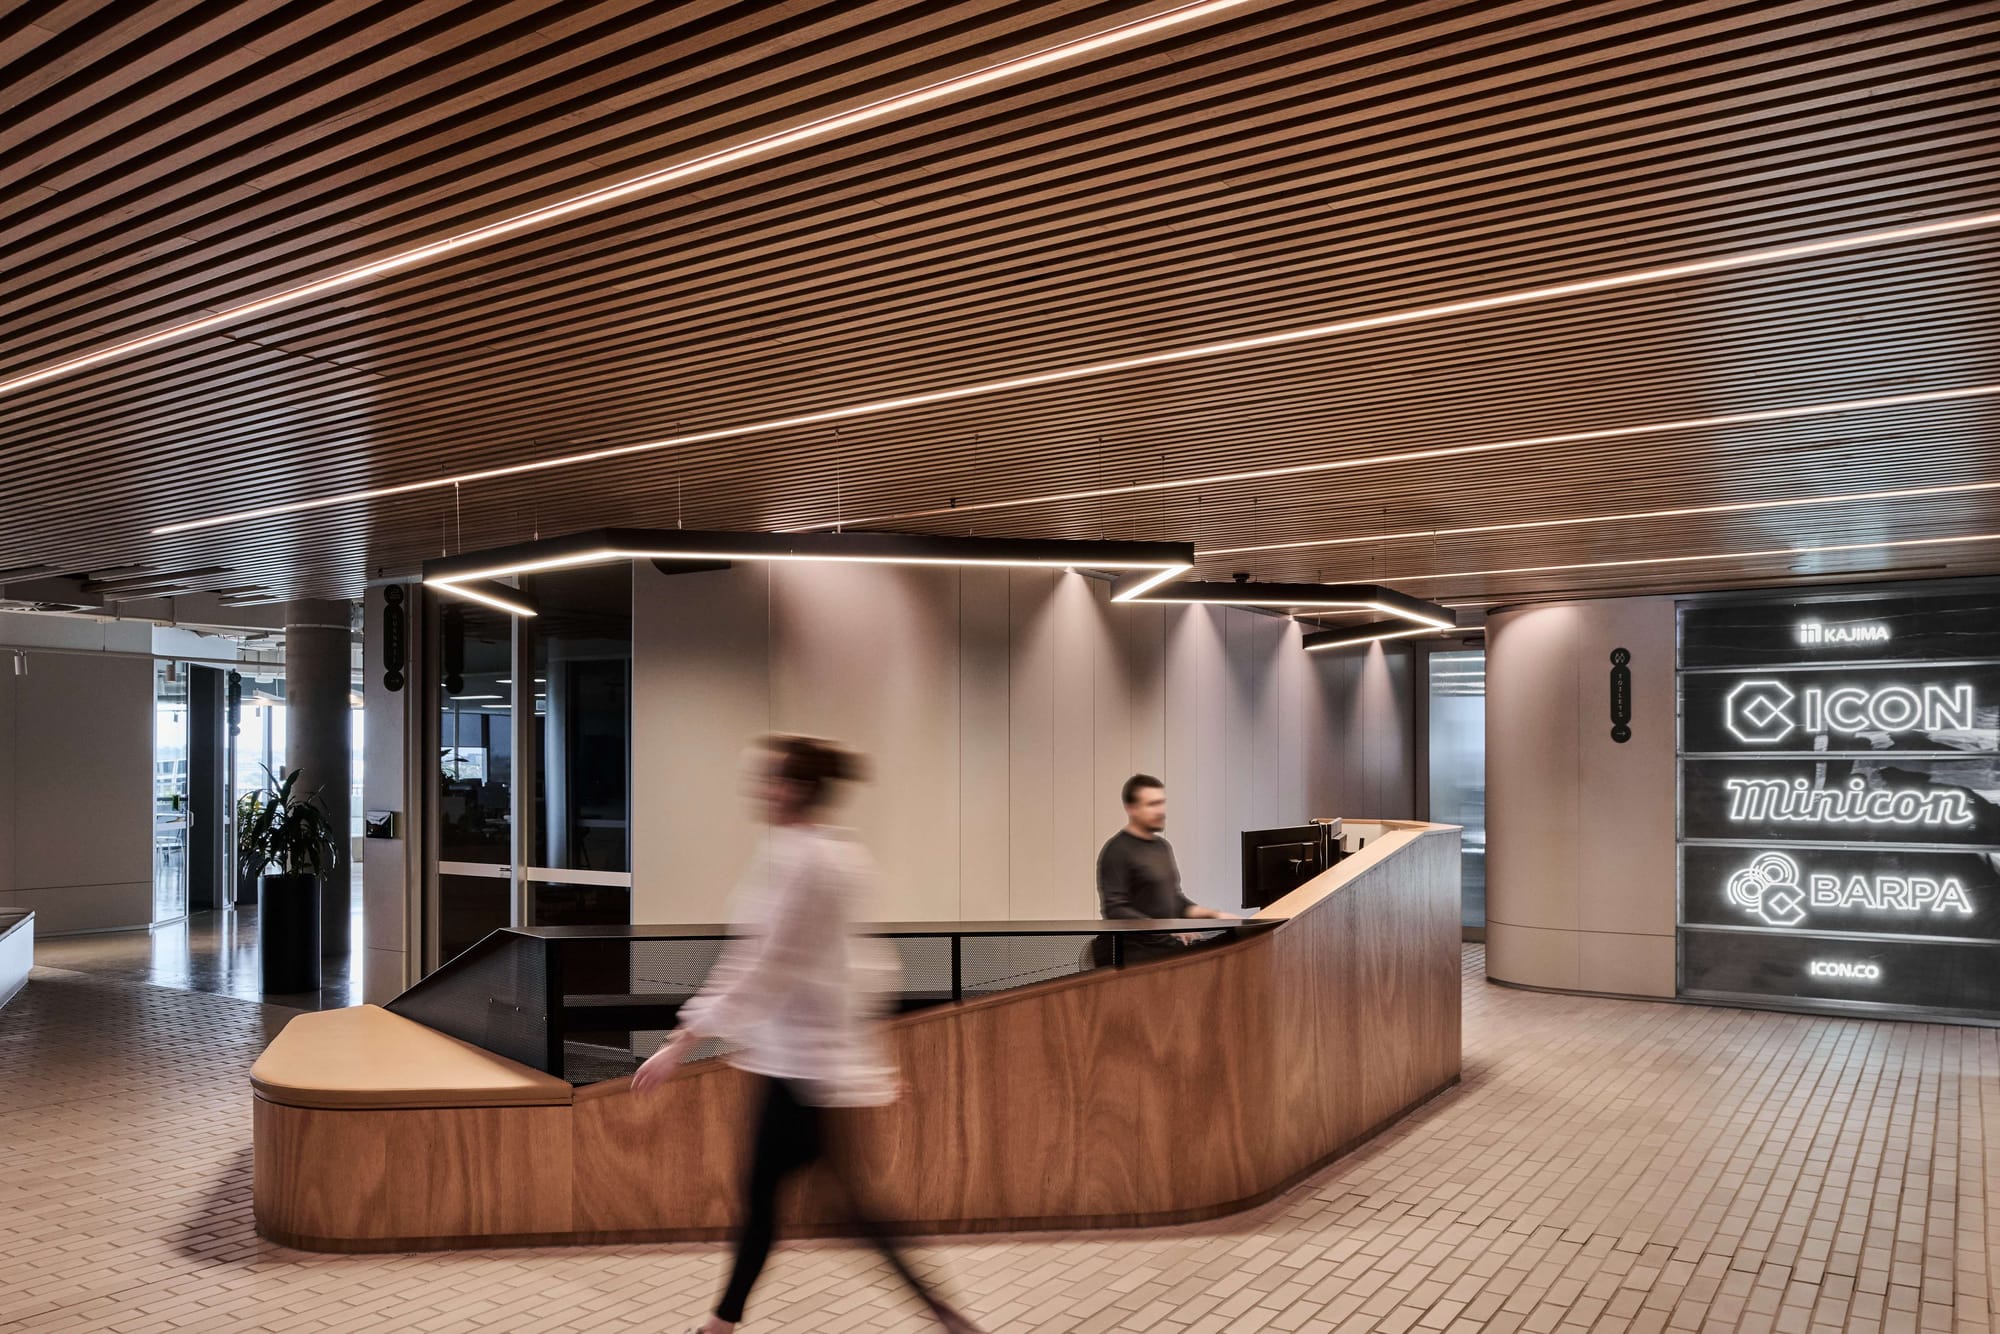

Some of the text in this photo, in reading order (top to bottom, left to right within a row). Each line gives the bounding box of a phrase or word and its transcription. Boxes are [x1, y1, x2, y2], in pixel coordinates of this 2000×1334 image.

[1824, 626, 1889, 643] KAJIMA
[1805, 686, 1973, 733] ICON
[1810, 874, 1973, 914] BARPA
[1811, 961, 1879, 979] ICON.CO
